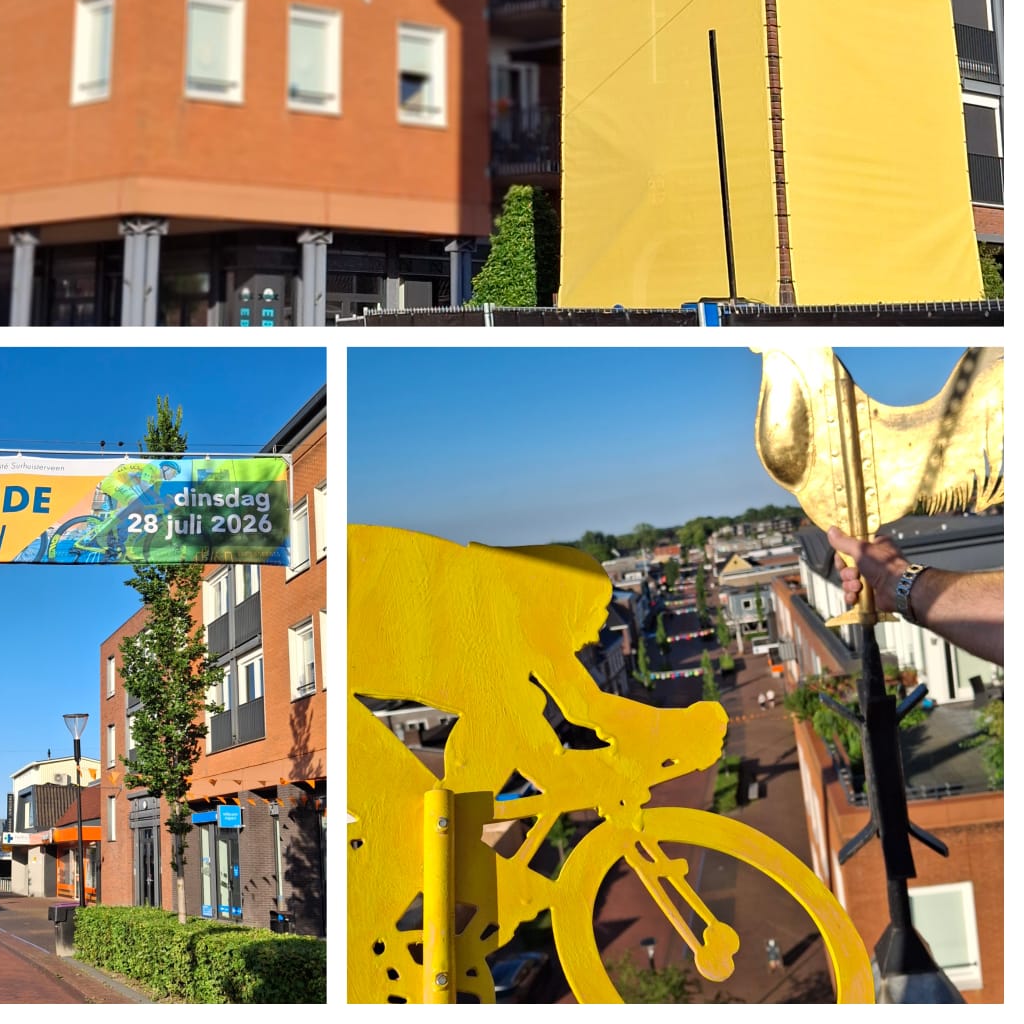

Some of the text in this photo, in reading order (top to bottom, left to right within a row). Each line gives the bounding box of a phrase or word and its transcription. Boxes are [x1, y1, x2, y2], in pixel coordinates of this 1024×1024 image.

[11, 462, 65, 472] Surhuisterveen
[174, 487, 270, 512] dinsdag
[127, 513, 273, 541] 28 juli 2026
